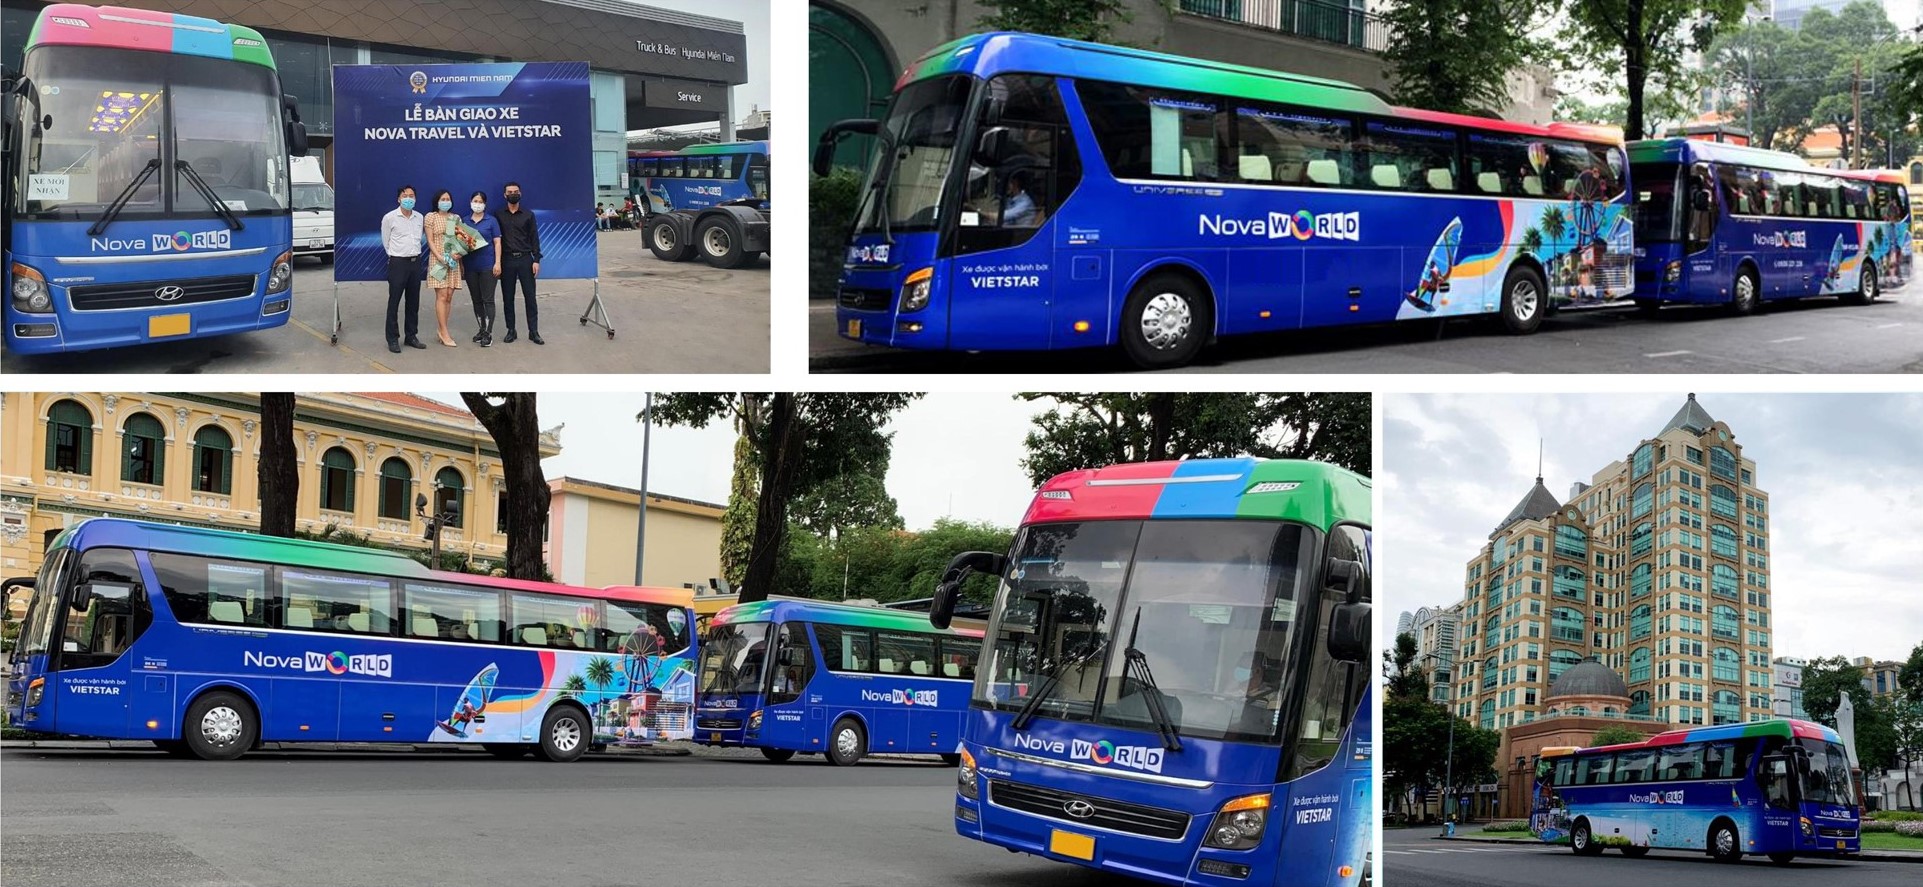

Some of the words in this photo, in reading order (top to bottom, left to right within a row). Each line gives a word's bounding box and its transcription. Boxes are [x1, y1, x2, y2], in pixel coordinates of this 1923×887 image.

[636, 40, 656, 53] Truck
[657, 43, 663, 54] &
[664, 44, 677, 56] Bus
[682, 47, 706, 60] Hyundai
[493, 74, 513, 82] NAM
[677, 91, 702, 103] Service
[405, 102, 422, 121] LỄ
[425, 105, 456, 121] BÀN
[459, 107, 497, 120] GIAO
[499, 106, 519, 119] XE
[364, 127, 407, 140] NOVA
[409, 126, 466, 140] TRAVEL
[467, 123, 489, 139] VÀ
[489, 124, 562, 138] VIETSTAR
[1199, 213, 1266, 236] Nova
[1268, 209, 1360, 242] WORLD
[92, 237, 146, 251] Nova
[152, 229, 231, 252] WORLD
[961, 265, 973, 273] Xe
[971, 275, 1040, 288] VIETSTAR
[244, 650, 303, 669] Nova
[305, 650, 392, 678] WORLD
[70, 685, 120, 695] VIETSTAR
[862, 689, 892, 702] Nova
[892, 688, 938, 707] WORLD
[776, 714, 801, 722] VIETSTAR
[1014, 732, 1065, 754] Nova
[1070, 738, 1165, 774] WORLD
[1293, 796, 1300, 806] Xe
[1629, 793, 1650, 803] Nova
[1296, 807, 1332, 825] VIETSTAR
[1767, 819, 1789, 827] VIETSTAR
